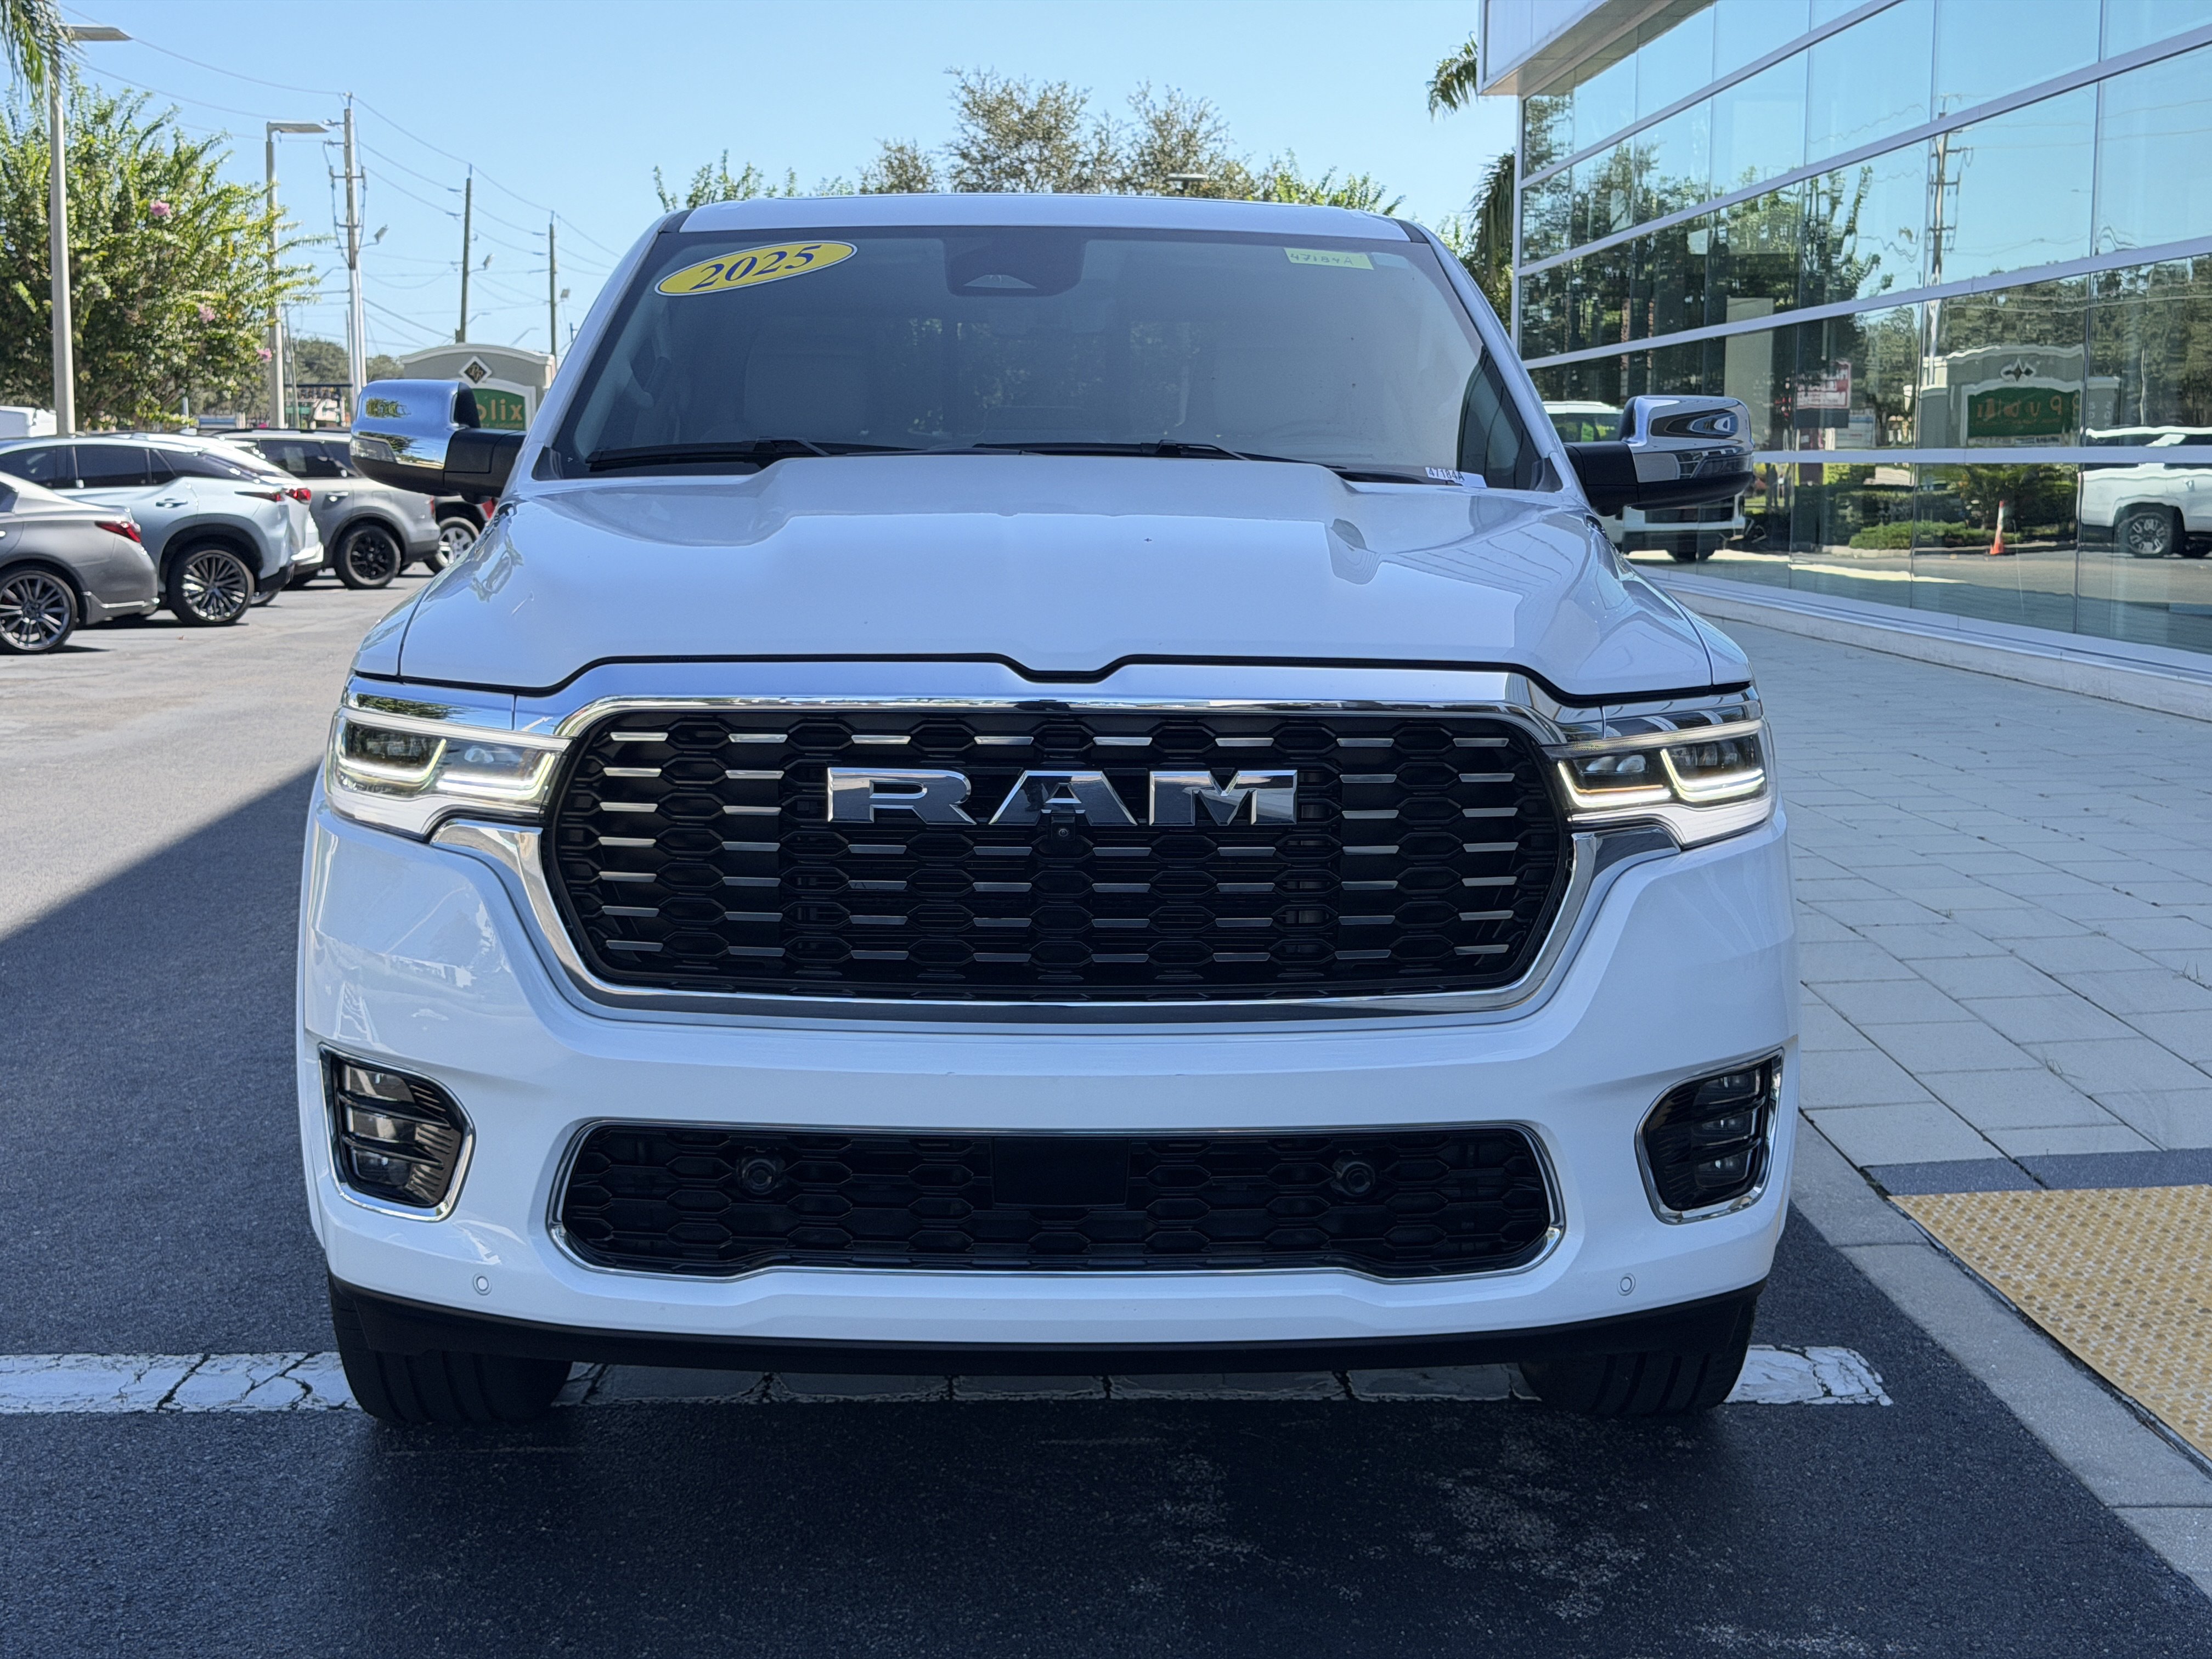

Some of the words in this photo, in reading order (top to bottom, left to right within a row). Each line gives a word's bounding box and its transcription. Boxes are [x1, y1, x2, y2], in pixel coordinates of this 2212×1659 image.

[689, 244, 822, 290] 2025
[1429, 468, 1465, 481] 47184A
[827, 766, 1297, 826] RAM
